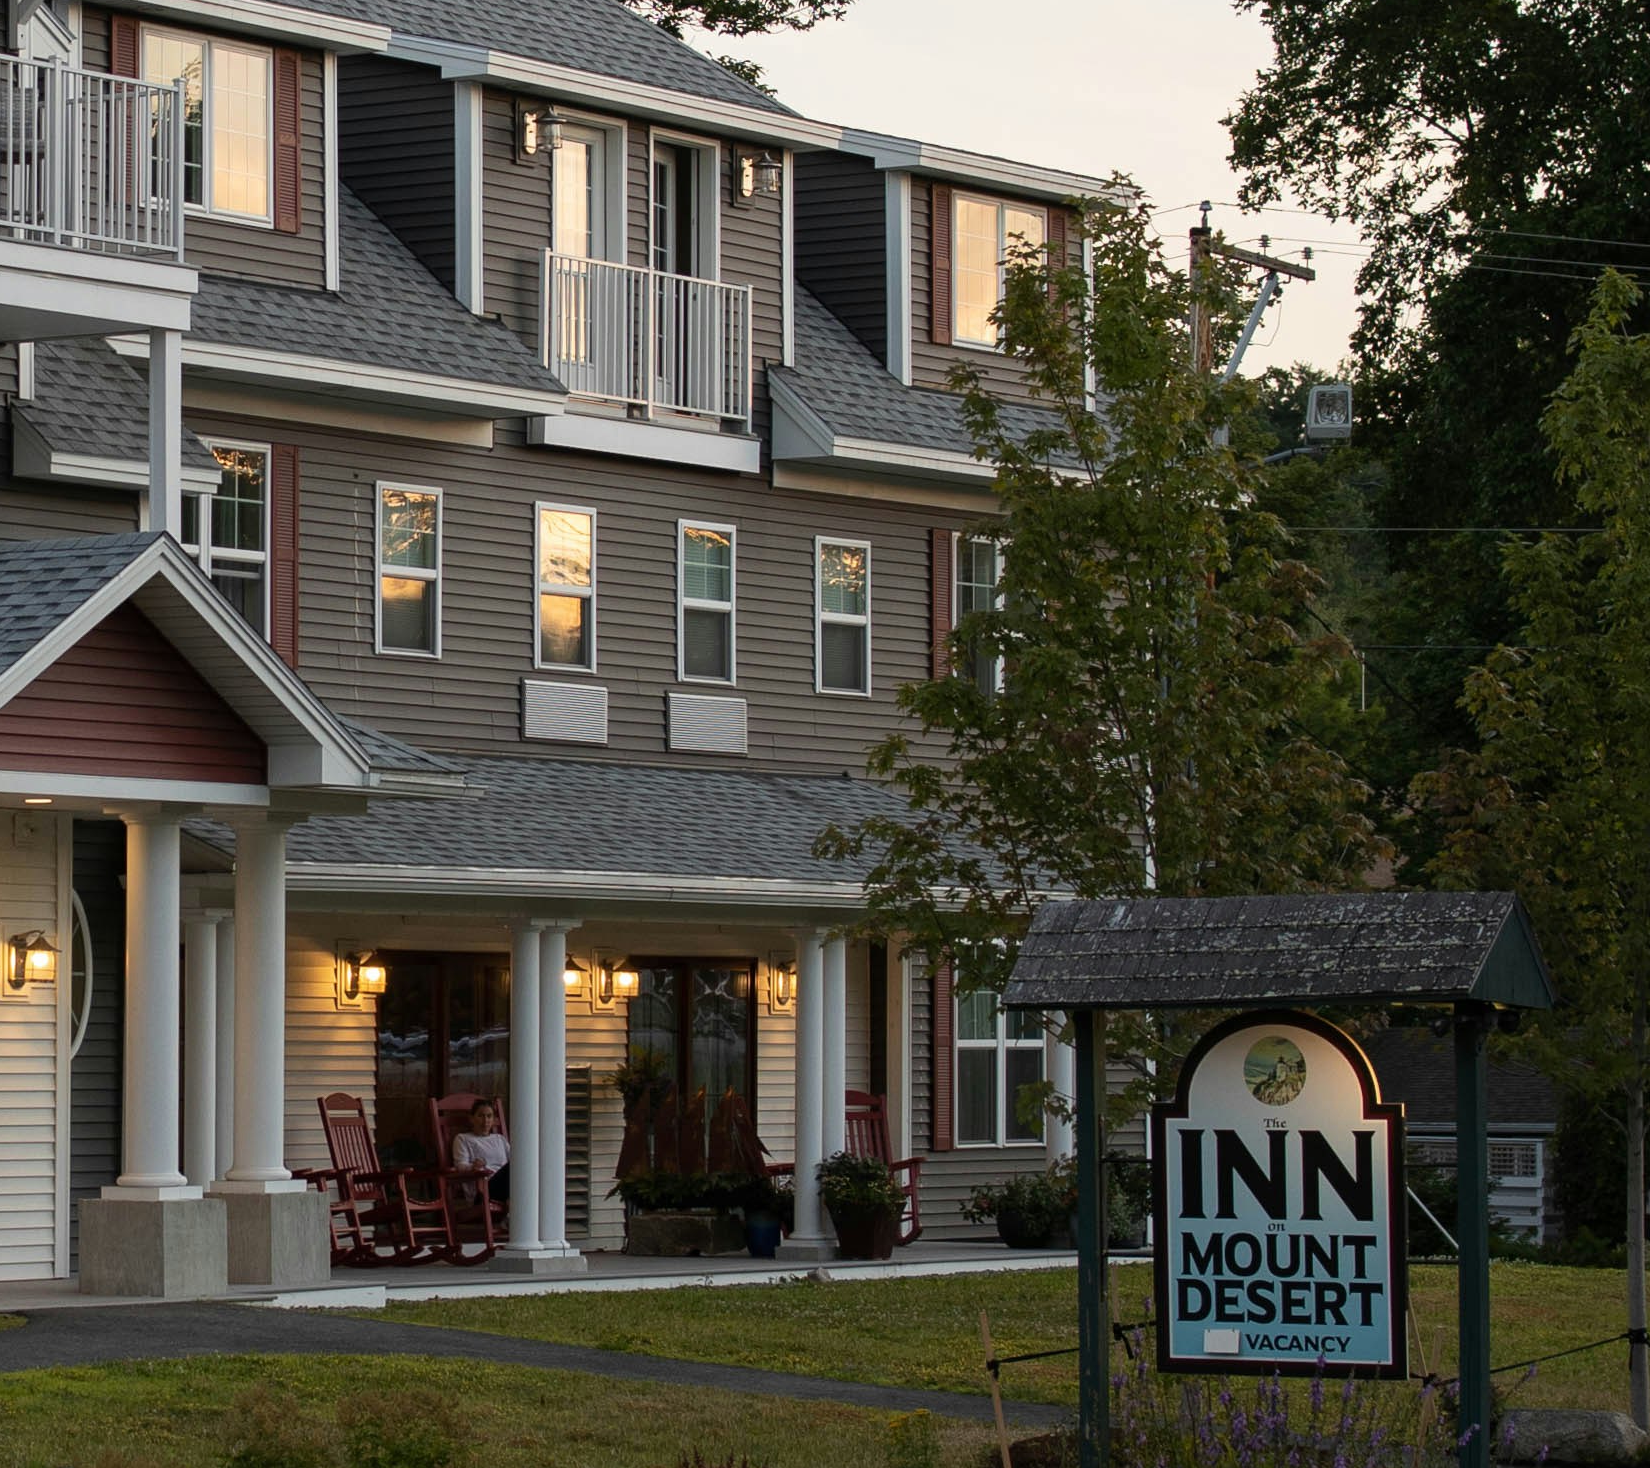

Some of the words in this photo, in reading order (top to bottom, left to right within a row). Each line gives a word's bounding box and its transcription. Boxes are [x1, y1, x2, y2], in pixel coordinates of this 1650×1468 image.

[1263, 1118, 1287, 1128] The
[1177, 1129, 1376, 1221] INN
[1267, 1223, 1286, 1232] on
[1181, 1232, 1378, 1279] MOUNT
[1176, 1278, 1384, 1327] DESERT
[1245, 1334, 1352, 1353] VACANCY
